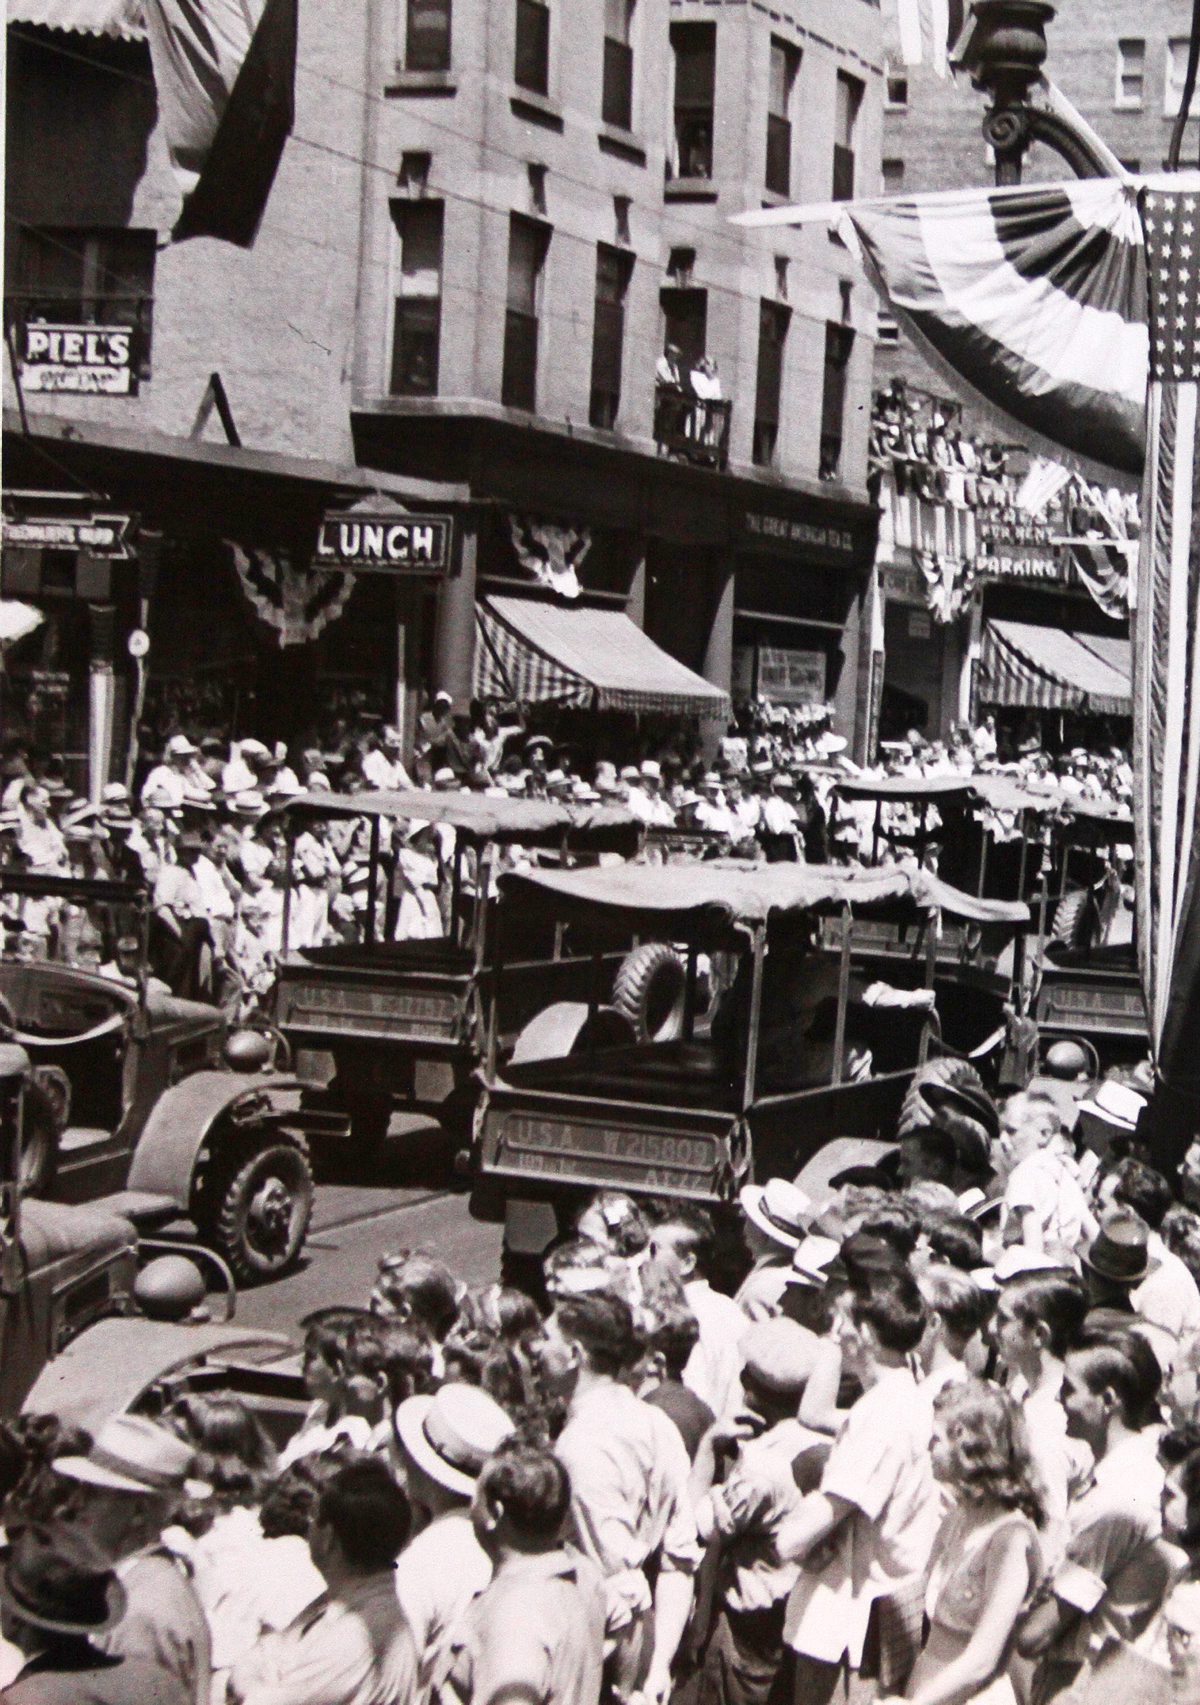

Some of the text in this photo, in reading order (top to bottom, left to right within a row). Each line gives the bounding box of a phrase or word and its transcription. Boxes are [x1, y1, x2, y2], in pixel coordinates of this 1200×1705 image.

[27, 331, 129, 365] PIEL'S
[318, 524, 433, 559] LUNCH
[975, 556, 1058, 578] PARKING
